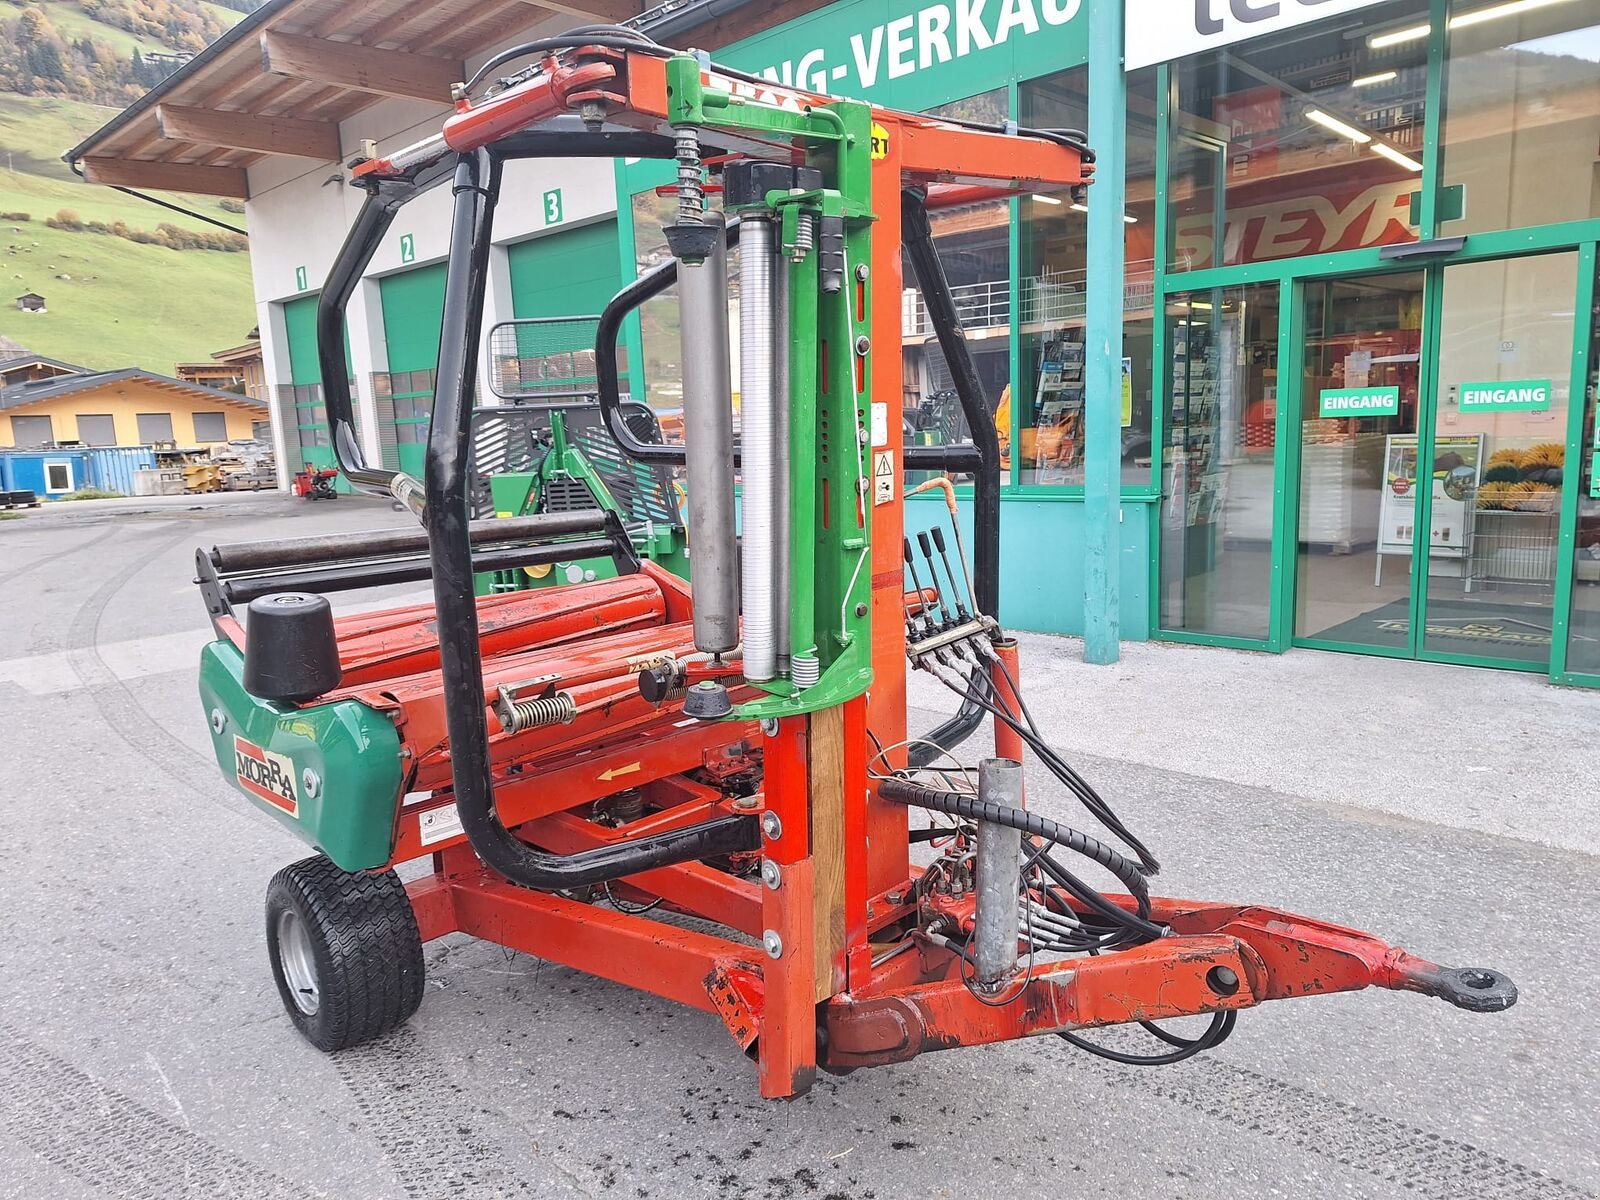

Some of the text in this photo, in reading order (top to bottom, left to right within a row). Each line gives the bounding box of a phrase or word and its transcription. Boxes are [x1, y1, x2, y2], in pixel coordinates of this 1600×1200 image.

[547, 192, 560, 223] 3
[1175, 177, 1422, 270] STEYR
[402, 236, 414, 262] 2
[298, 266, 307, 290] 1
[1323, 393, 1394, 410] EINGANG
[1463, 387, 1546, 405] EINGANG
[236, 751, 297, 802] MORRA
